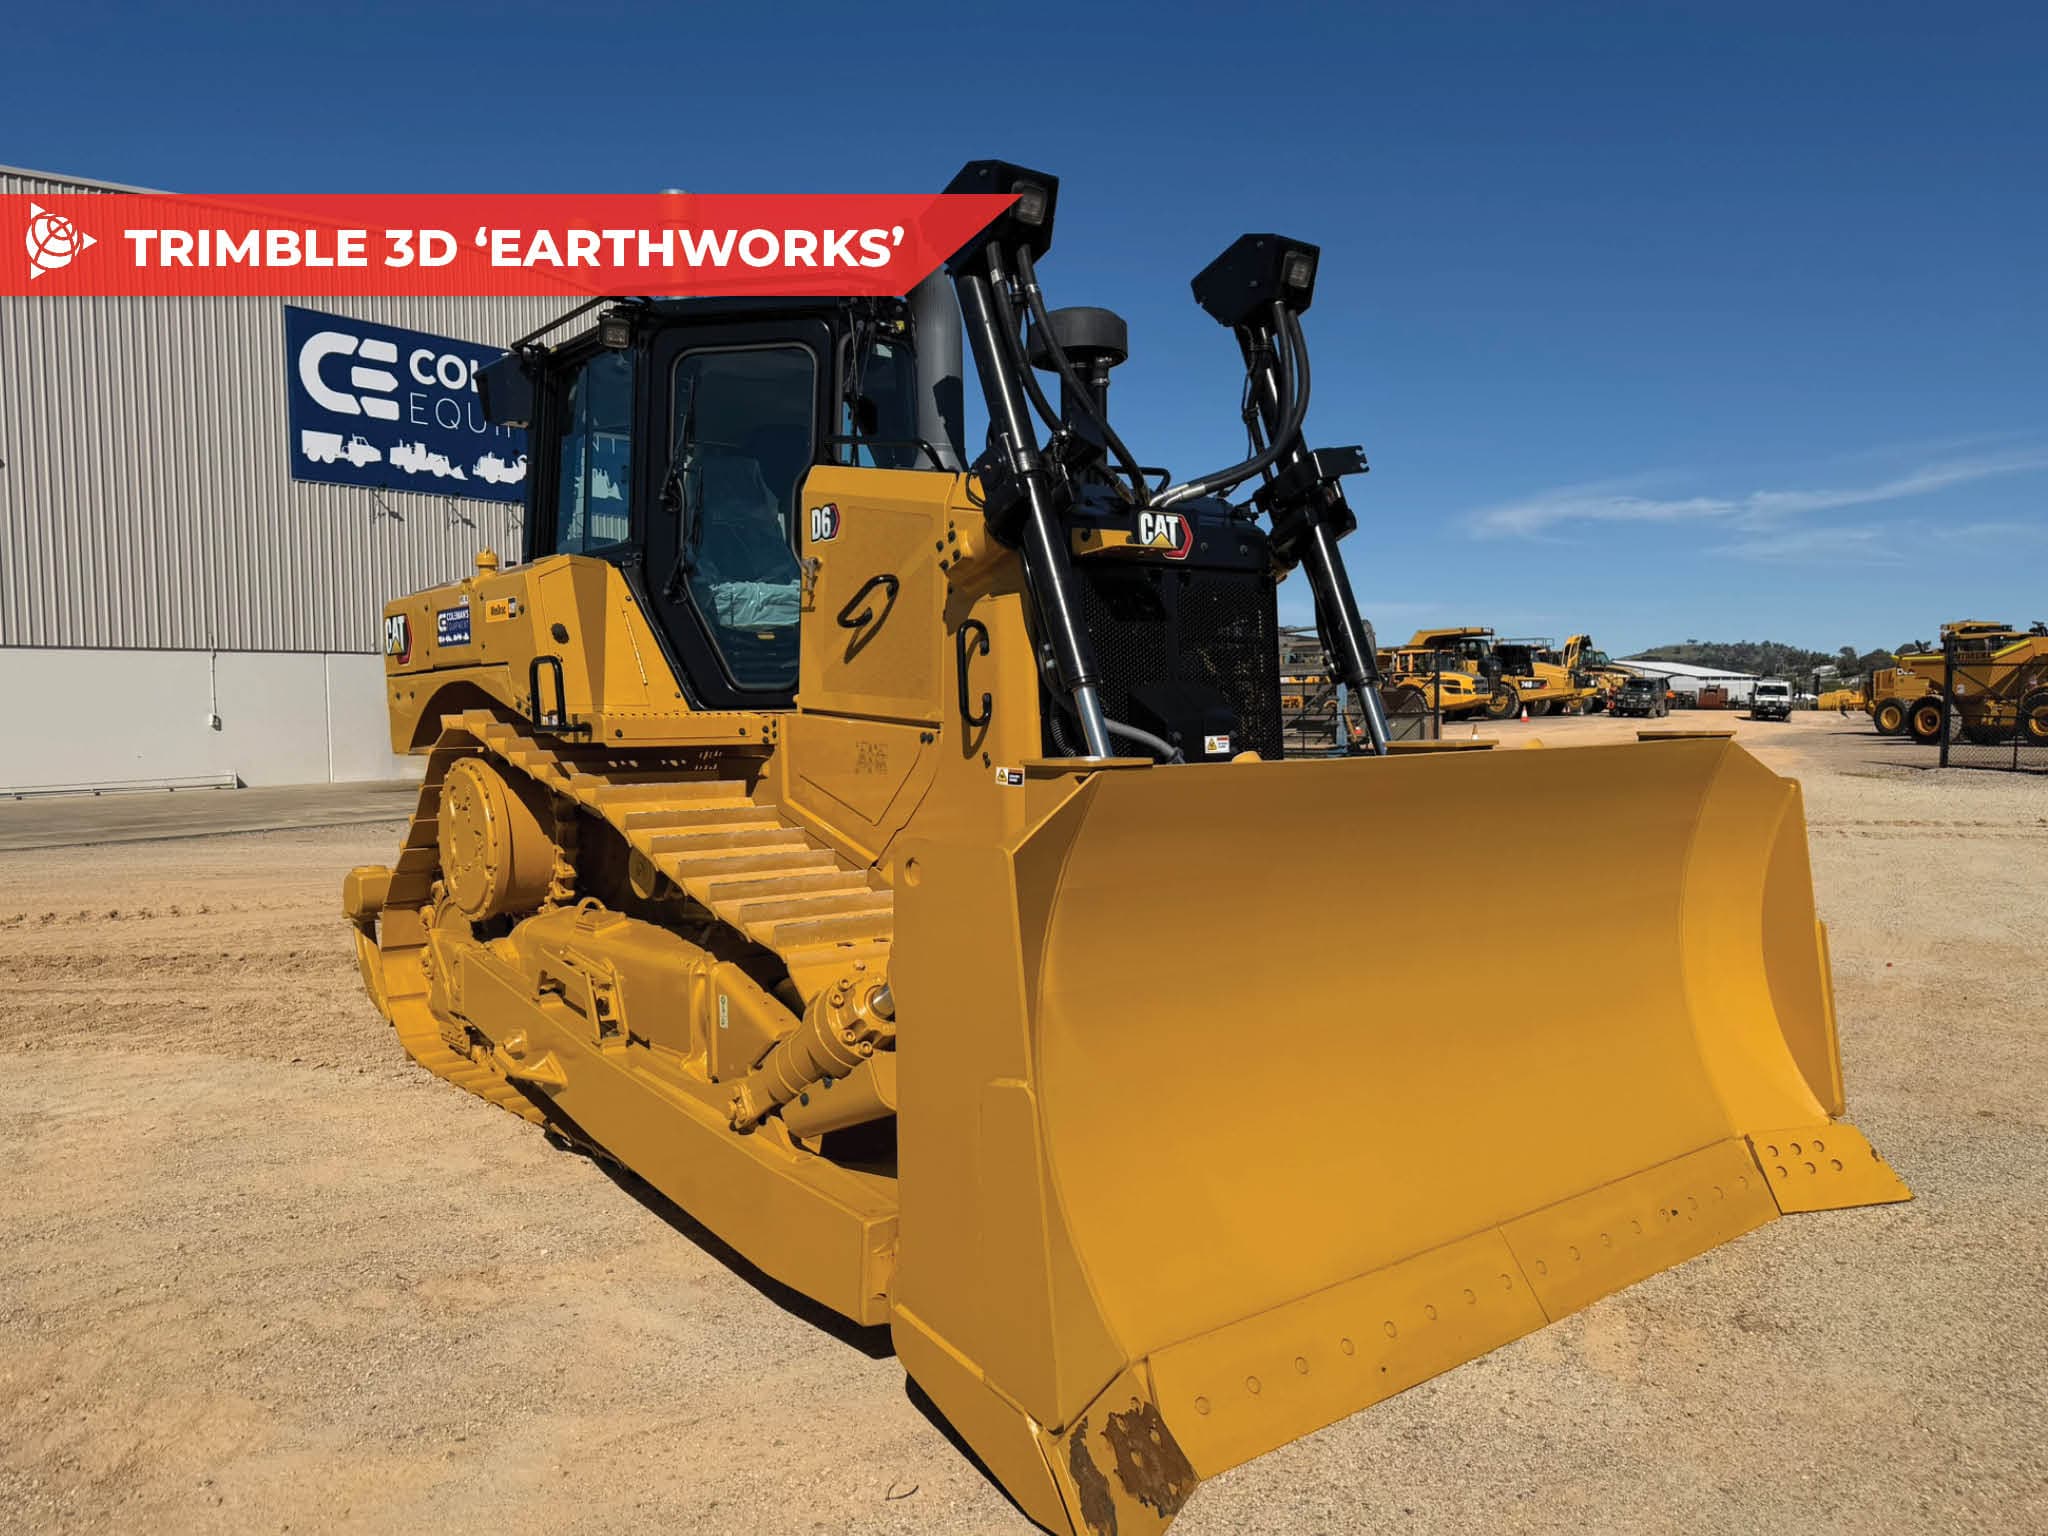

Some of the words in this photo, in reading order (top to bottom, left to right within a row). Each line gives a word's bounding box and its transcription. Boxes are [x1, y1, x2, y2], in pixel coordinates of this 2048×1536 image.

[811, 505, 831, 541] D6
[1140, 512, 1179, 547] CAT
[385, 615, 405, 656] CAT
